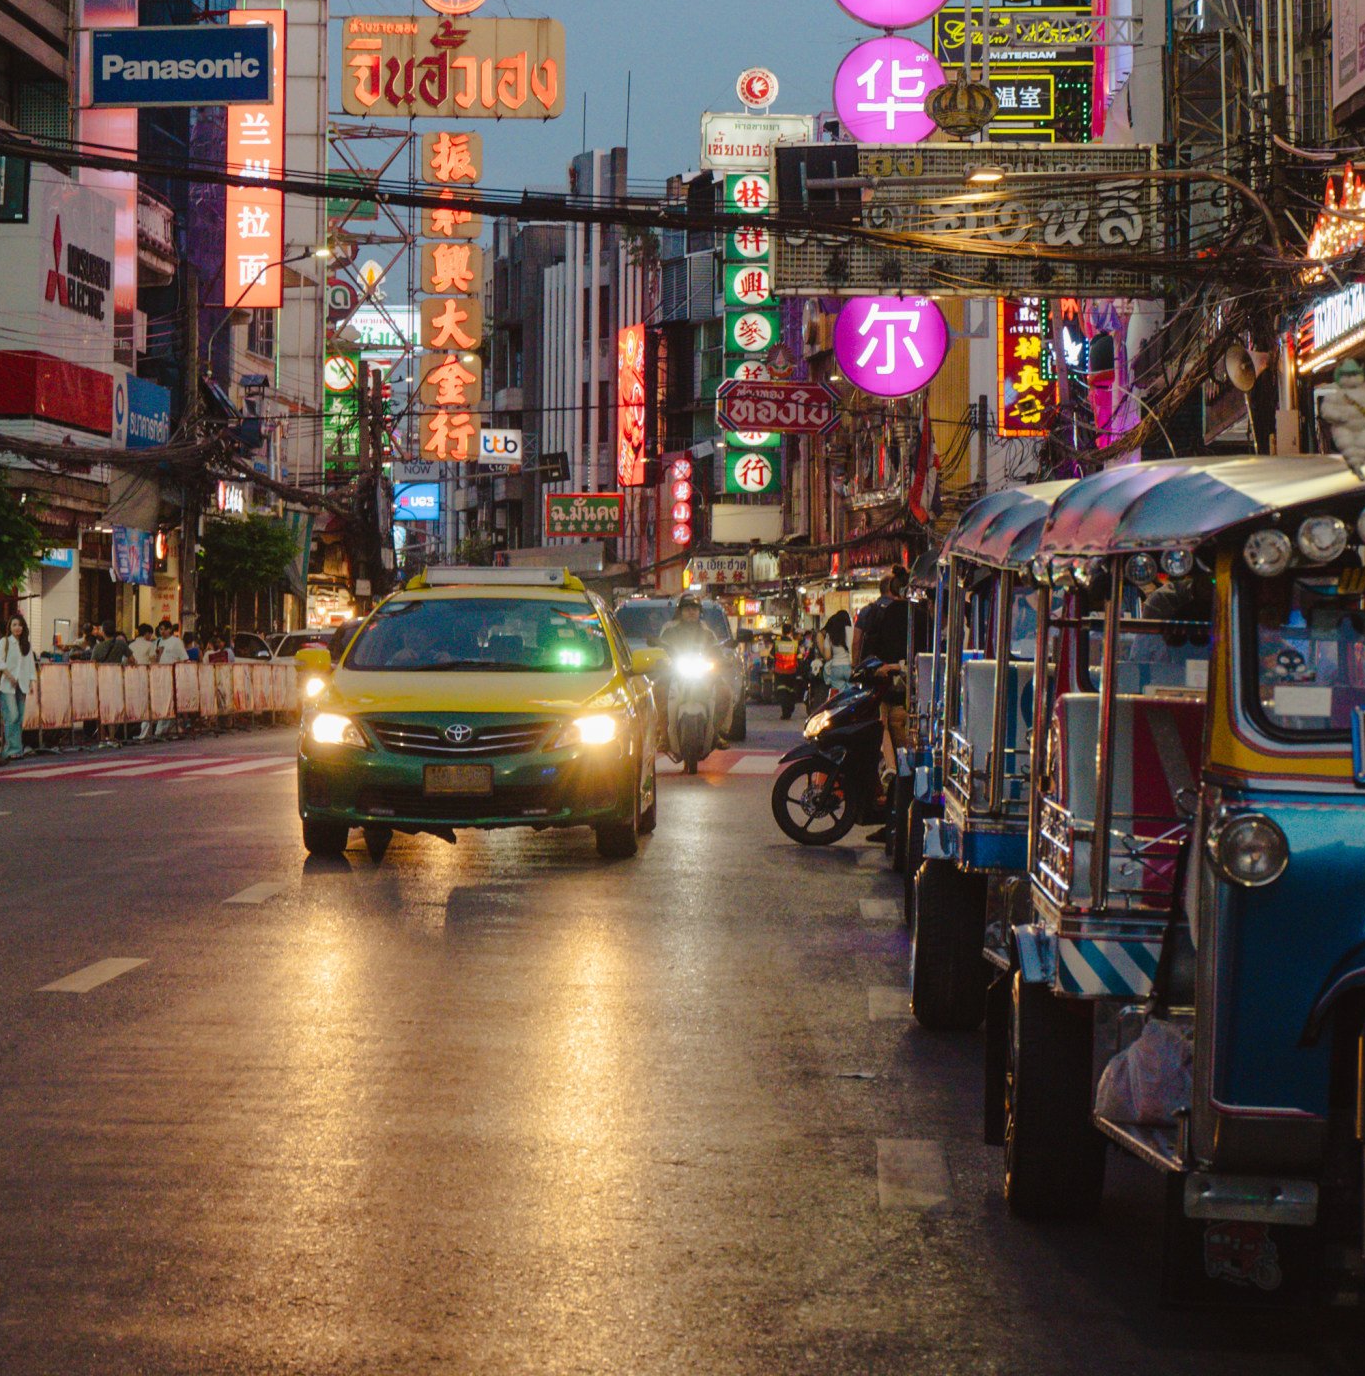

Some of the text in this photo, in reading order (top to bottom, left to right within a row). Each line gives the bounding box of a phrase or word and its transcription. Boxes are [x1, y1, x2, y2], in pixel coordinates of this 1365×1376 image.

[101, 51, 260, 81] Panasonic
[346, 20, 558, 110] จินฮั้วเฮง
[989, 51, 1057, 60] MSTERDAM
[67, 242, 111, 292] MITSUBISHI
[67, 277, 106, 322] ELECTRIC
[857, 302, 925, 375] 尔
[730, 390, 830, 425] ทองใบ
[483, 435, 518, 454] ttb
[404, 465, 431, 475] NOW
[550, 497, 620, 522] ฉ.มั่นคง
